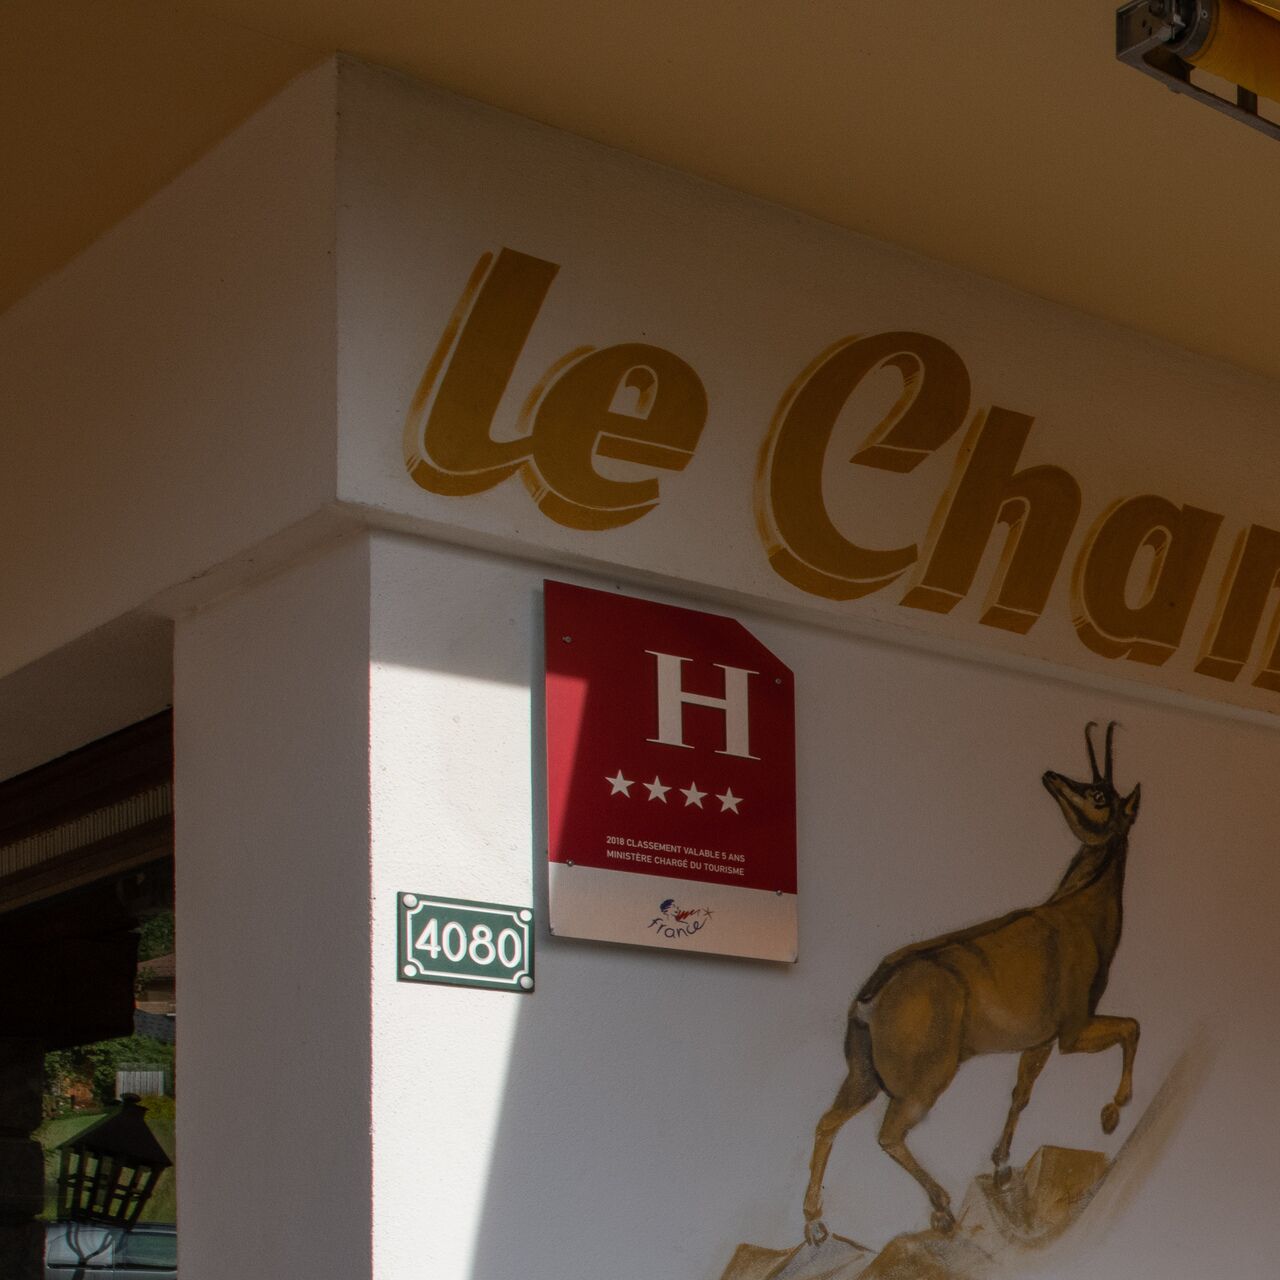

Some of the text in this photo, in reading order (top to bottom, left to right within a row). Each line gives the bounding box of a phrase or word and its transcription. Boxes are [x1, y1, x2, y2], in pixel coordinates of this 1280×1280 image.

[405, 247, 708, 531] le
[645, 650, 761, 760] H
[606, 836, 746, 863] 2018 CLASSEMENT VALABLE 5 ANS
[606, 850, 745, 876] MINISTÈRE CHARGÉ DU TOURISME
[415, 918, 522, 969] 4080
